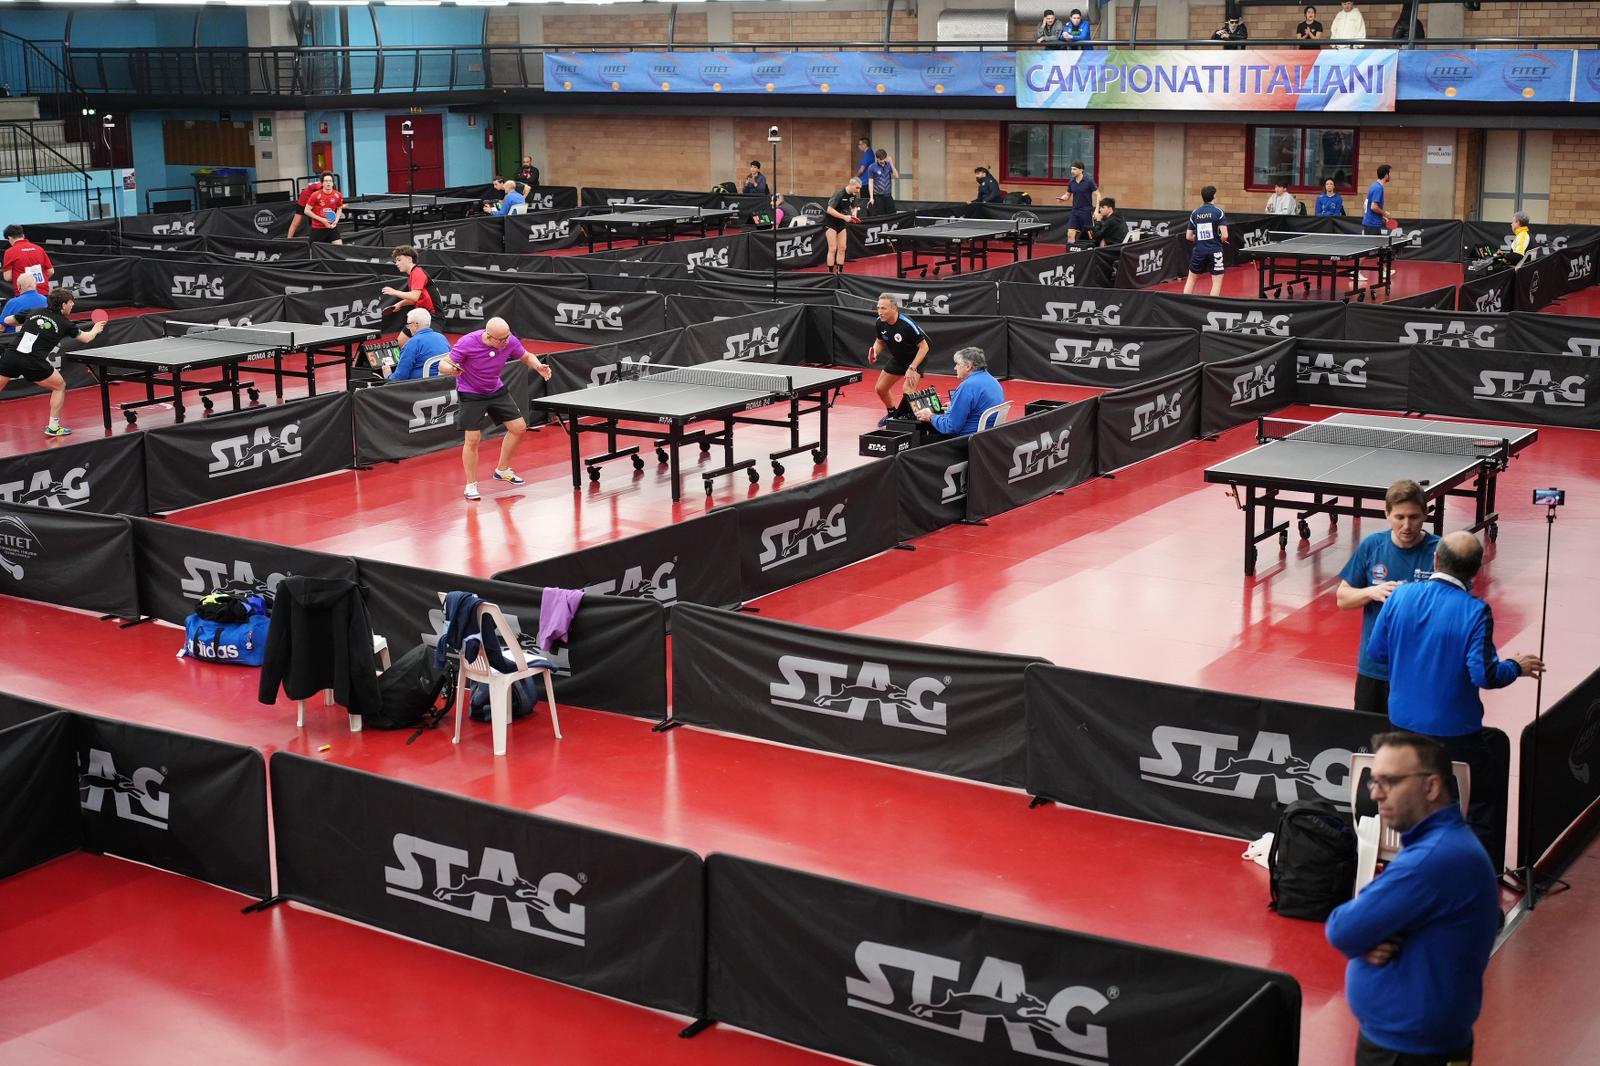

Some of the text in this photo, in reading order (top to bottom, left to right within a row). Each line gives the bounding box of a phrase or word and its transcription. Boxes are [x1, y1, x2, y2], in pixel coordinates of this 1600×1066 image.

[1026, 63, 1385, 95] CAMPIONATI ITALIANI
[1433, 66, 1471, 75] FITET
[1511, 66, 1550, 75] FITET
[152, 221, 196, 236] STAG
[413, 229, 456, 249] STAG
[529, 220, 570, 243] STAG
[1125, 219, 1169, 237] TAG
[1199, 230, 1212, 240] 115
[686, 247, 729, 273] STAG
[776, 236, 813, 260] STAG
[1038, 265, 1075, 286] STAG
[1135, 249, 1163, 276] STAG
[1567, 254, 1592, 281] STAG
[171, 274, 224, 299] STAG
[322, 299, 383, 328] STAG
[554, 302, 623, 330] STAG
[1041, 300, 1121, 325] STAG
[1202, 310, 1290, 336] STAG
[723, 326, 780, 361] STAG
[1399, 320, 1495, 348] STAG
[247, 350, 276, 361] ROMA 24
[1050, 337, 1141, 371] STAG
[1230, 365, 1275, 407] STAG
[1473, 369, 1586, 407] STAG
[746, 398, 771, 410] ROMA 24
[1130, 393, 1182, 441] STAG
[208, 424, 302, 478] STAG
[1007, 430, 1070, 484] STAG
[0, 467, 90, 510] TAG
[759, 503, 847, 571] STAG
[769, 654, 947, 735] STAG
[1139, 725, 1353, 812] STAG
[78, 747, 170, 830] AG
[384, 832, 586, 947] STAG
[845, 940, 1110, 1066] STAG
